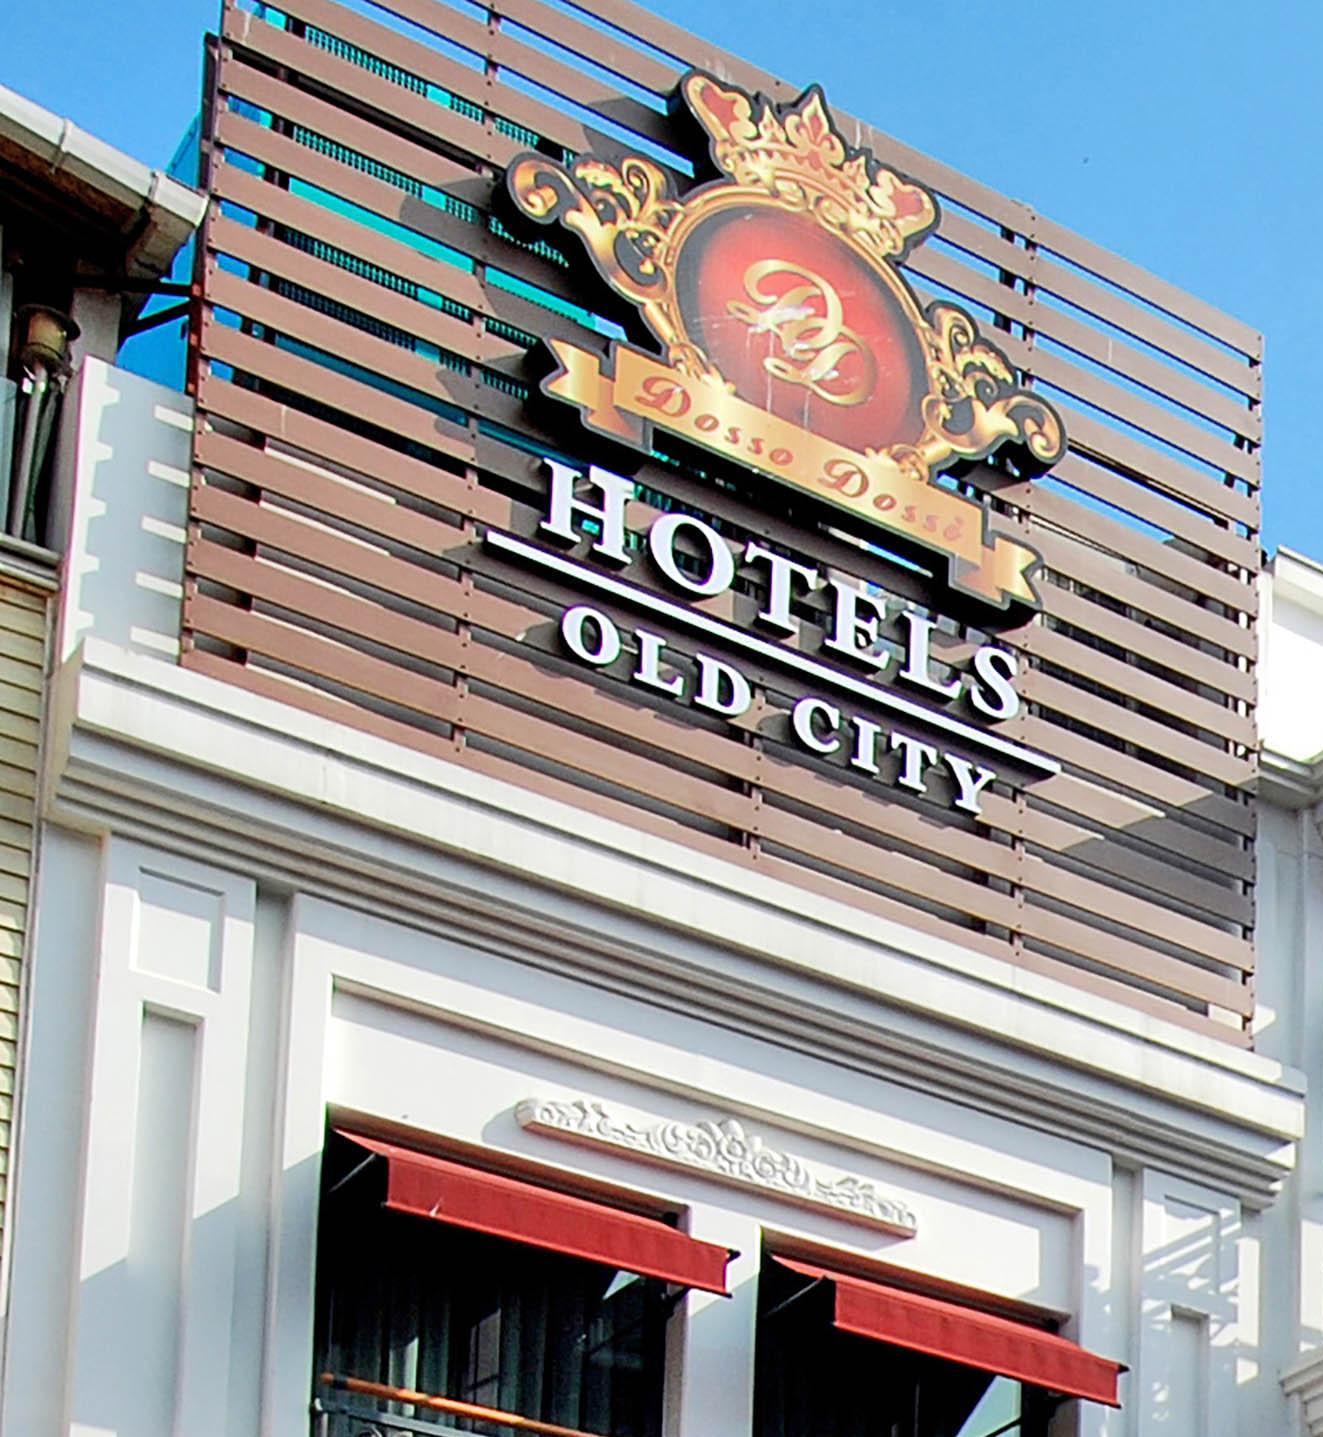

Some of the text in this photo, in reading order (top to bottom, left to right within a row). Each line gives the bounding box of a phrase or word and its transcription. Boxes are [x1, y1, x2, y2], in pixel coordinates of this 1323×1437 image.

[634, 376, 794, 466] Dosso
[541, 457, 1020, 721] HOTELS
[561, 605, 997, 815] OLD CITY
